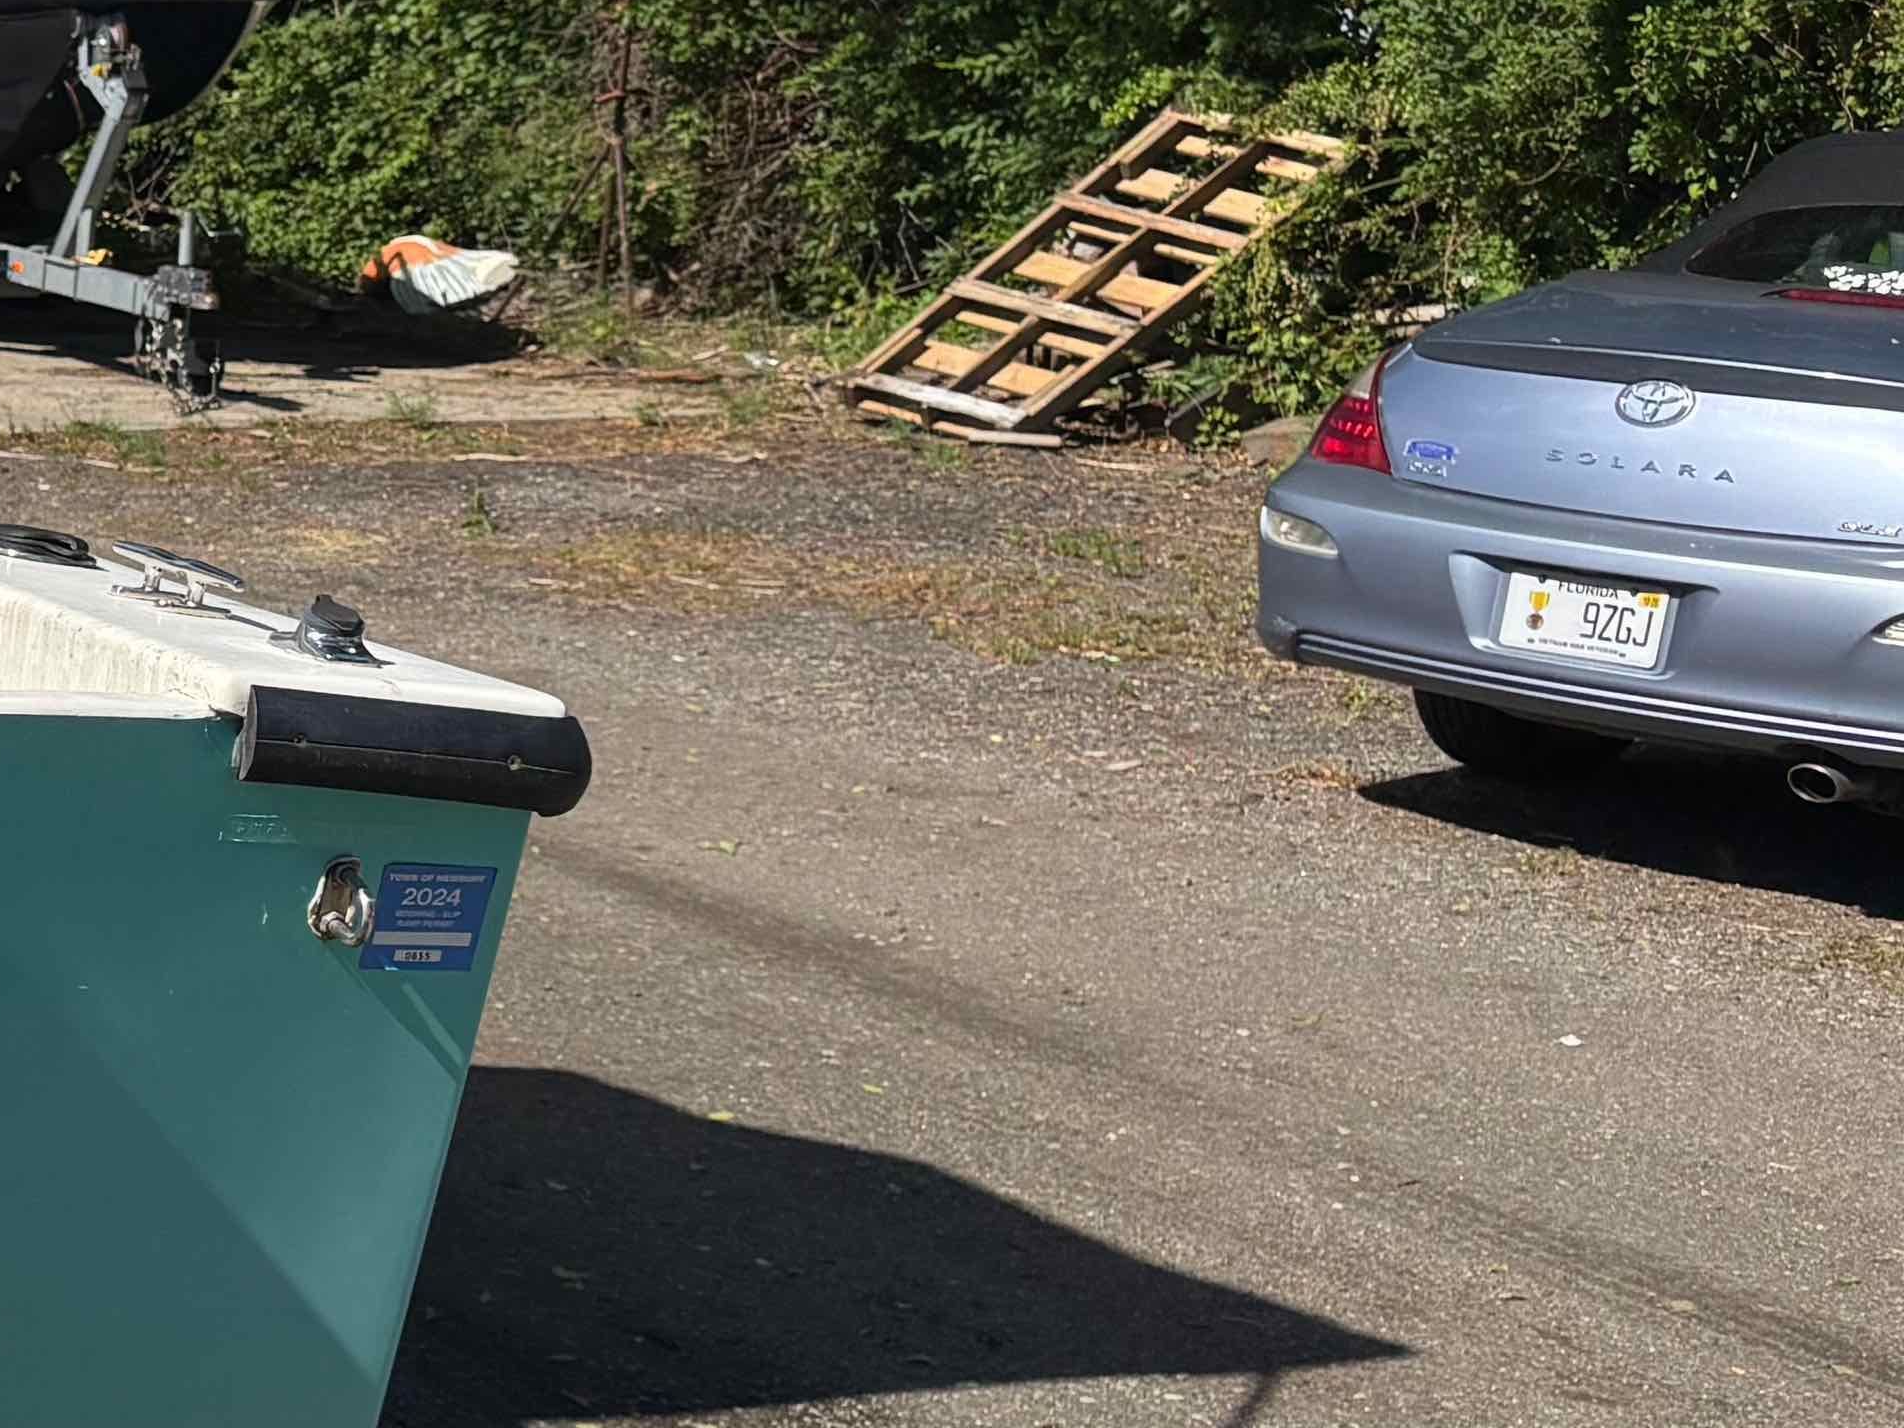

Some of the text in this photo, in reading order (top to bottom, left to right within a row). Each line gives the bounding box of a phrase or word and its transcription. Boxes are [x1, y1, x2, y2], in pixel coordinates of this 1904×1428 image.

[1544, 449, 1736, 484] SOLARA
[1558, 582, 1619, 600] FLORIDA
[1579, 601, 1654, 648] 9ZGJ
[400, 887, 462, 907] 2024
